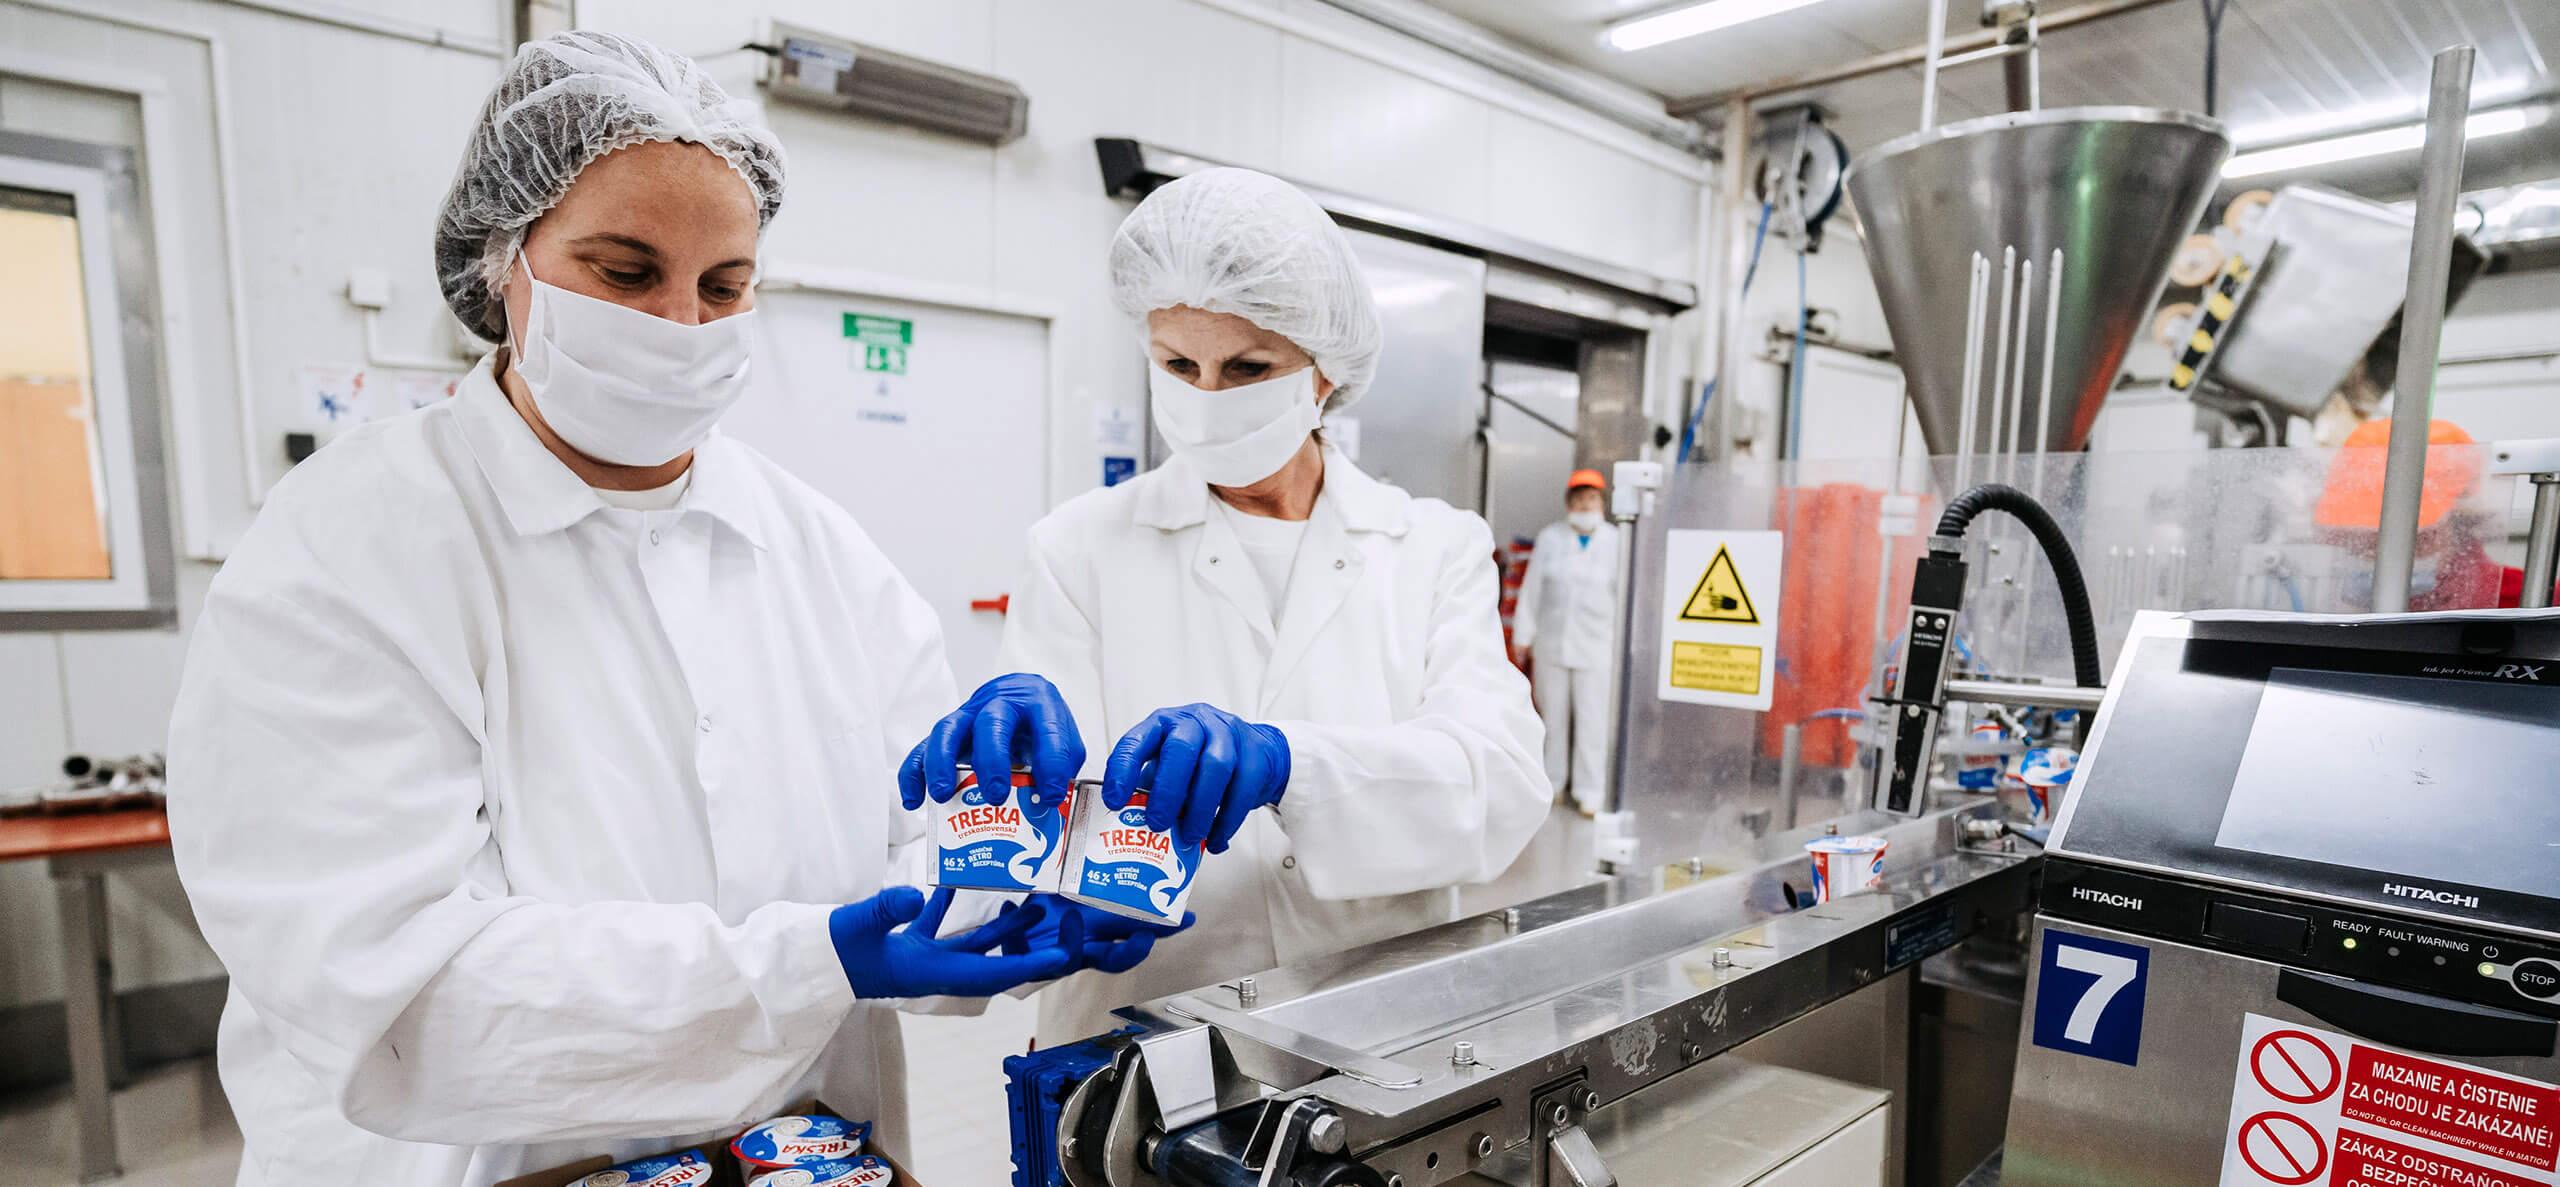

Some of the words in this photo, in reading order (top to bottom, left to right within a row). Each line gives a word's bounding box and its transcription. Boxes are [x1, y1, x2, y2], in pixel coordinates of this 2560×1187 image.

[2493, 664, 2545, 680] RX
[947, 806, 1020, 833] TRESKA
[1099, 829, 1170, 854] TRESKA
[943, 857, 956, 867] 46
[957, 857, 966, 868] %
[967, 852, 993, 863] RETRO
[1087, 869, 1100, 880] 46
[1102, 872, 1111, 883] %
[1114, 872, 1138, 881] RETRO
[2072, 887, 2143, 911] HITACHI
[2383, 883, 2479, 908] HITACHI
[2332, 919, 2371, 934] READY
[2378, 928, 2414, 942] FAULT
[2416, 935, 2470, 952] WARNING
[2520, 972, 2556, 986] STOP
[2056, 944, 2138, 1045] 7
[2371, 1061, 2442, 1093] MAZANIE
[2443, 1079, 2456, 1097] A
[2460, 1079, 2537, 1116] ČISTENIE
[2349, 1082, 2369, 1101] ZA
[2373, 1088, 2429, 1116] CHODU
[2431, 1103, 2453, 1122] JE
[2455, 1109, 2554, 1148] ZAKÁZANÉ!
[782, 1140, 851, 1154] TRESKA
[2346, 1108, 2358, 1116] DO
[2359, 1111, 2375, 1120] NOT
[2376, 1116, 2388, 1124] OIL
[2389, 1119, 2401, 1127] OR
[2402, 1122, 2429, 1135] CLEAN
[2429, 1129, 2478, 1147] MACHINERY
[2478, 1142, 2505, 1155] WHILE
[2506, 1150, 2515, 1158] IN
[2516, 1152, 2550, 1167] MATION
[2339, 1137, 2398, 1165] ZÁKAZ
[2401, 1155, 2519, 1187] ODSTRAŇ
[650, 1167, 704, 1187] TRES
[831, 1170, 884, 1187] TRES
[2362, 1163, 2444, 1187] BEZPE
